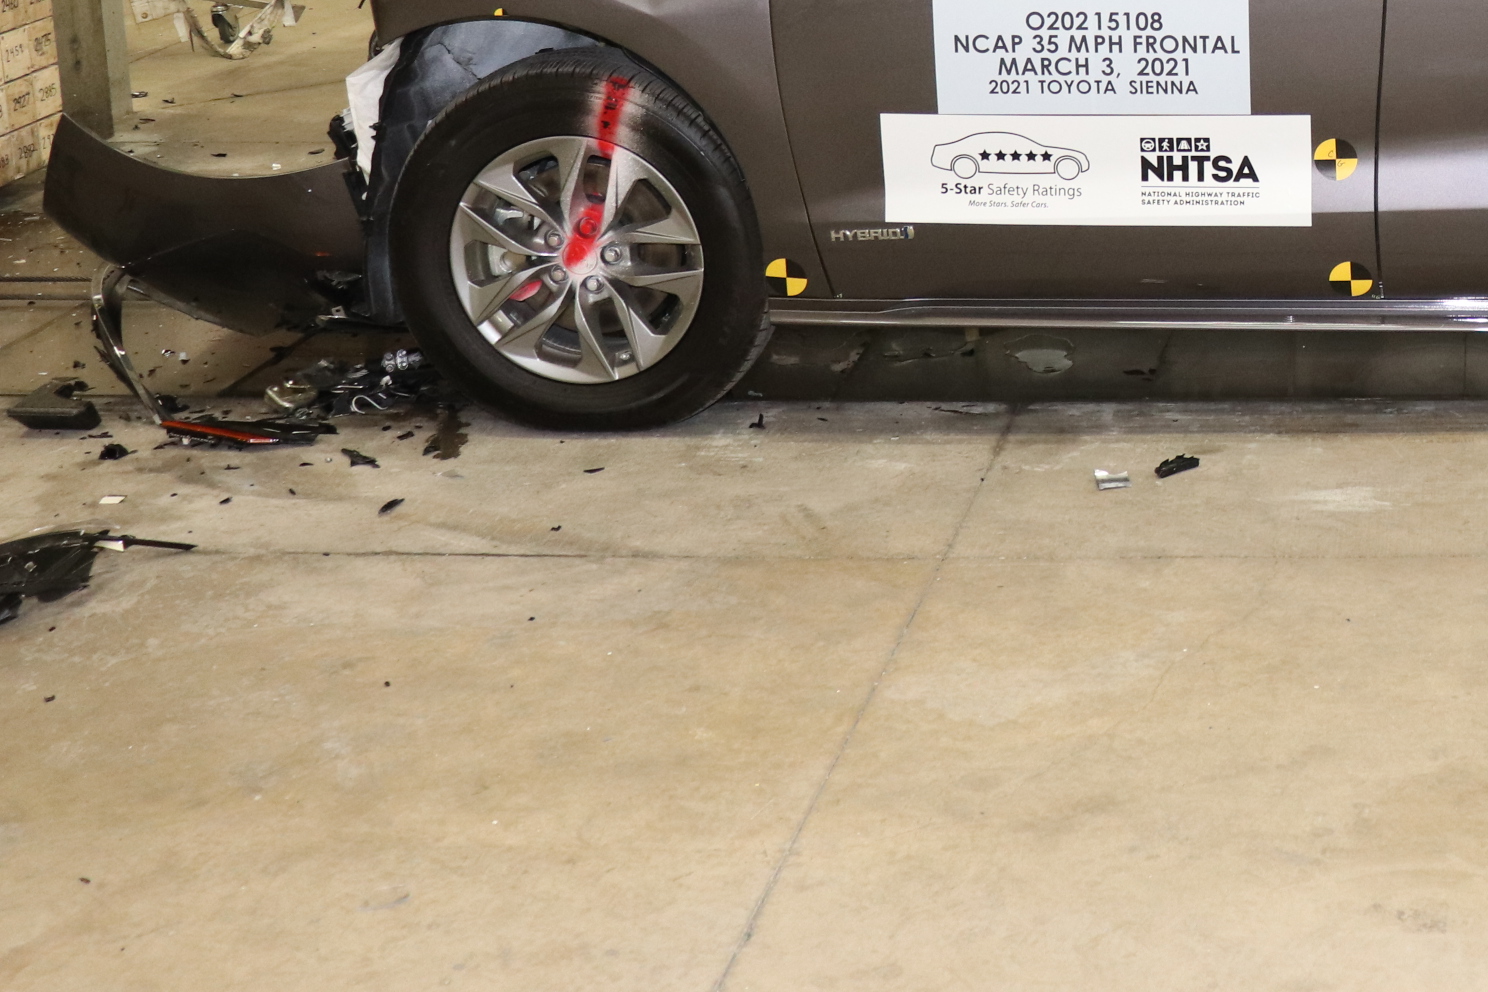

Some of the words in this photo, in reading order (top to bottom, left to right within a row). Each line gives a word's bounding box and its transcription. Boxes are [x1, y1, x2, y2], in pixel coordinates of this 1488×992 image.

[954, 34, 1022, 54] NCAP
[1032, 34, 1059, 53] 35
[1068, 35, 1122, 54] MPH
[1133, 35, 1240, 54] FRONTAL
[998, 57, 1090, 77] MARCH
[1101, 58, 1121, 79] 3,
[1137, 58, 1191, 77] 2021
[989, 80, 1030, 95] 2021
[1038, 80, 1118, 95] TOYOTA
[1129, 80, 1198, 95] SIENNA
[1140, 155, 1260, 183] NHTSA
[940, 183, 983, 195] 5-Star
[987, 183, 1029, 199] Safety
[1032, 184, 1082, 200] Ratings
[988, 200, 1009, 208] Stars.
[1010, 200, 1030, 208] Safer
[1031, 200, 1049, 208] Cars.
[830, 228, 901, 242] HYBRID
